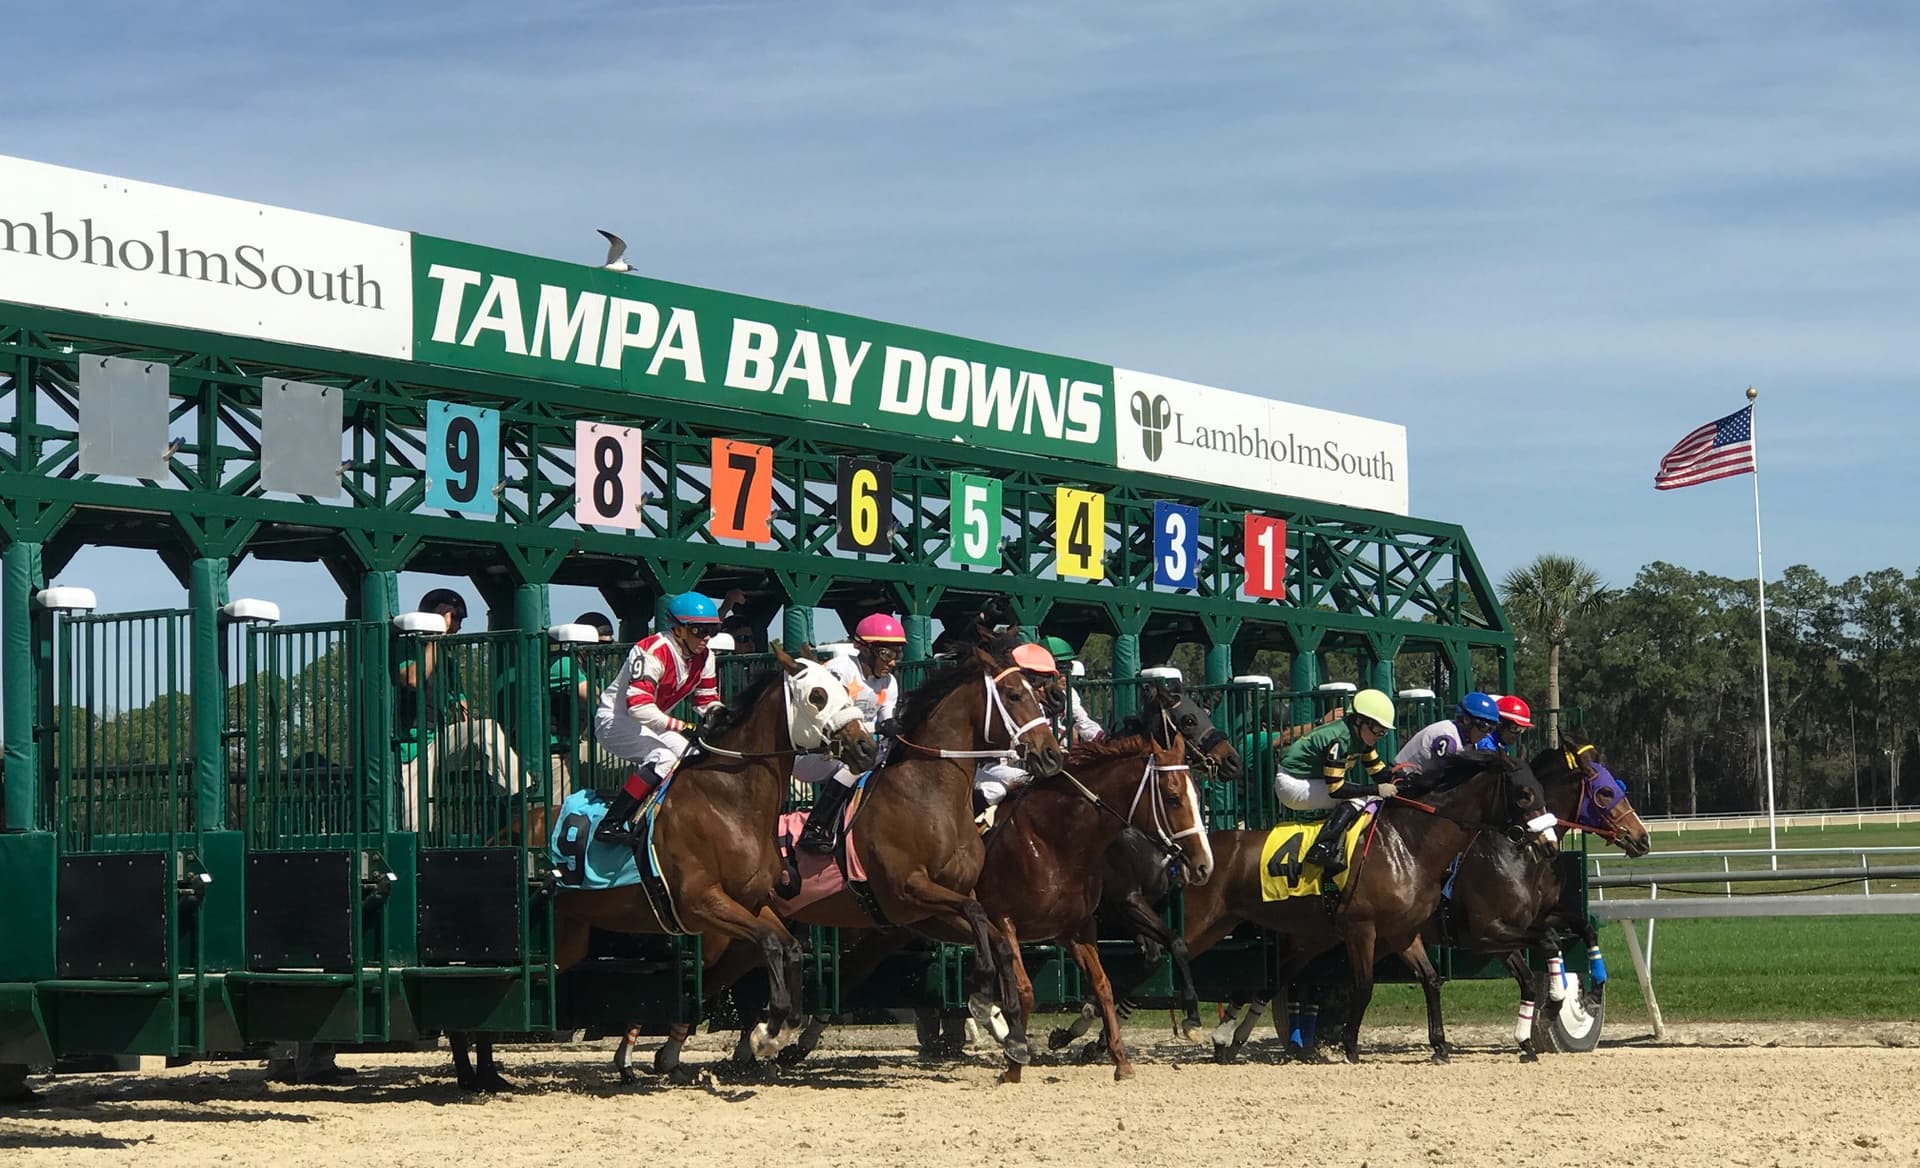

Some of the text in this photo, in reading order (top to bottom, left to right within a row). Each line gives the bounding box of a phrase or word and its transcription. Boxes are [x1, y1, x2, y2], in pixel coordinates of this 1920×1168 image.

[427, 263, 1103, 444] TAMPA BAY DOWNS
[445, 416, 480, 504] 9
[593, 435, 624, 519] 8
[1175, 412, 1395, 482] LambholmSouth
[726, 453, 757, 531] 7
[850, 468, 879, 546] 6
[963, 484, 989, 560] 5
[1068, 502, 1092, 569] 4
[1164, 512, 1187, 582] 3
[1257, 525, 1274, 591] 1
[632, 657, 644, 680] 9
[1329, 742, 1340, 761] 4
[1436, 739, 1448, 757] 3
[557, 813, 592, 886] 9
[1266, 831, 1305, 889] 4
